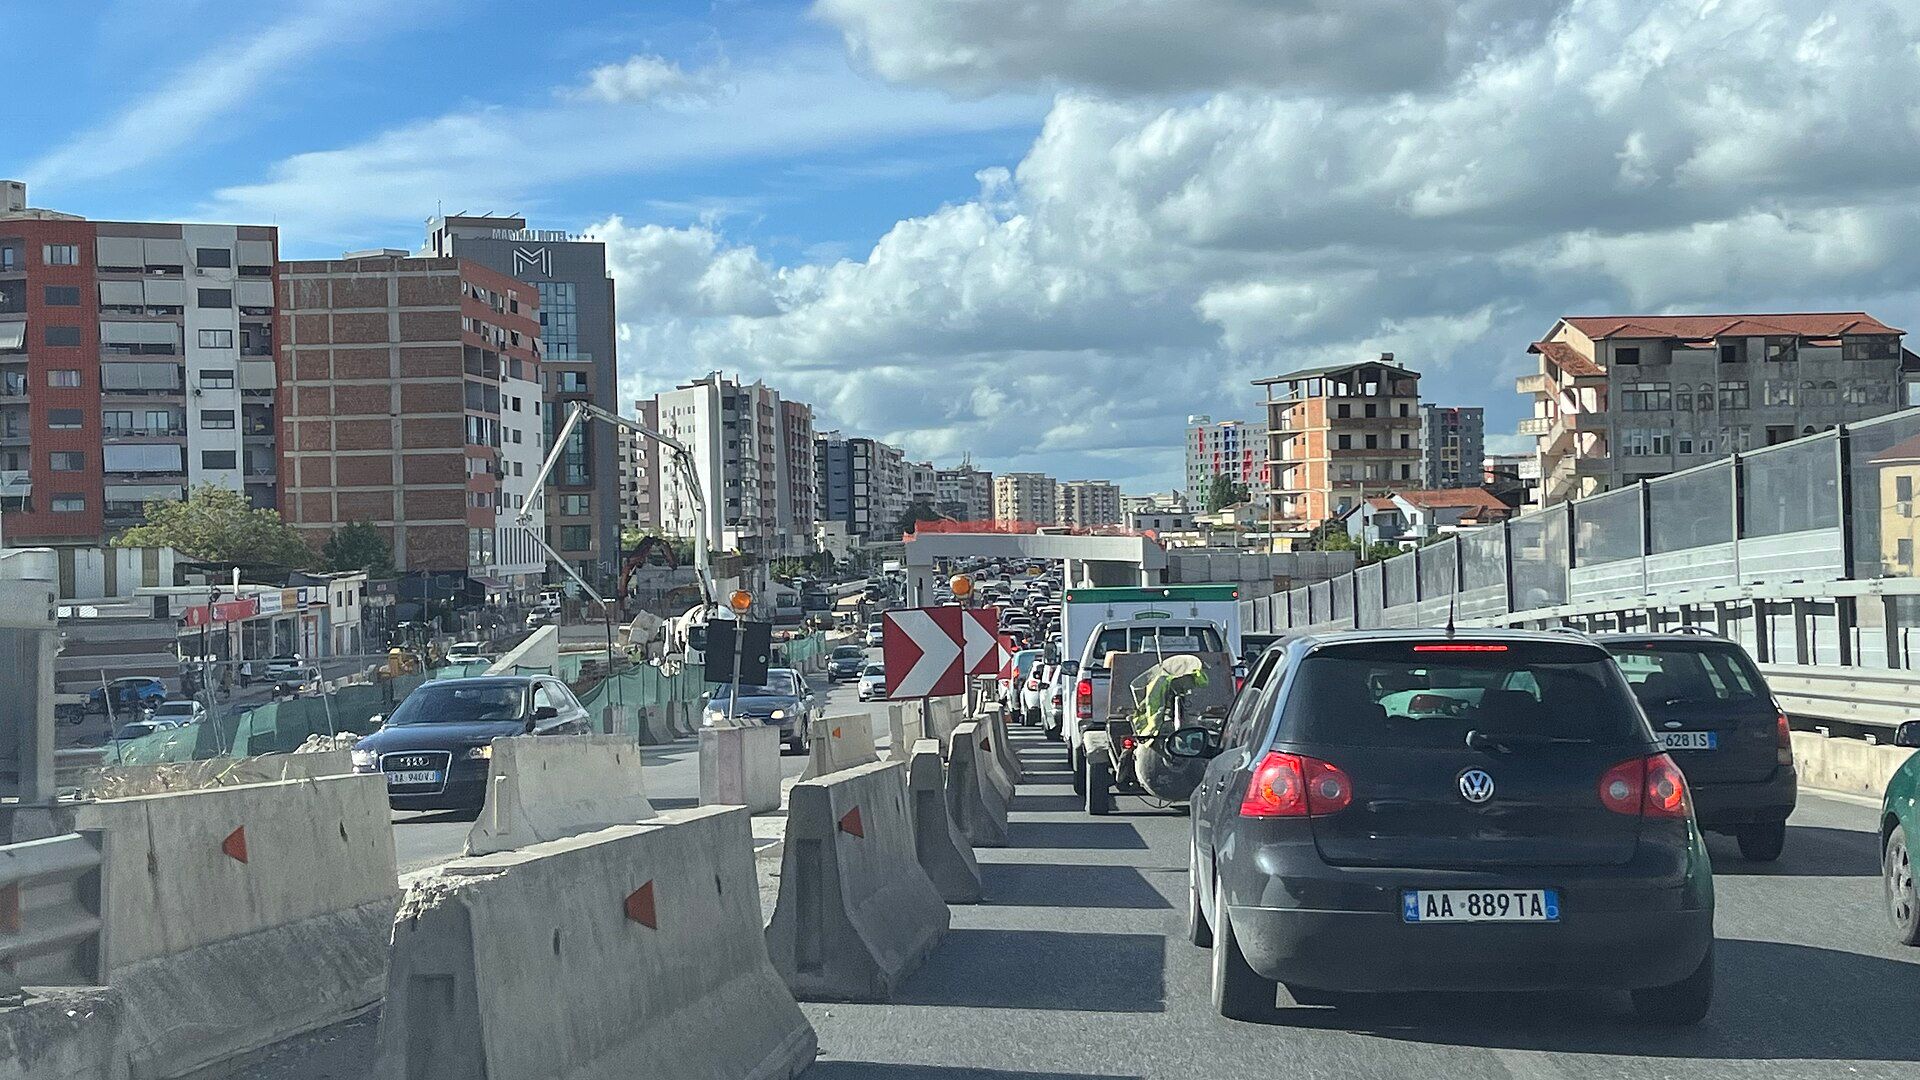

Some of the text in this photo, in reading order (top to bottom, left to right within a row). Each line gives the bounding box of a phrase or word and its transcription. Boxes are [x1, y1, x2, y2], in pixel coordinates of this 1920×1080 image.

[538, 230, 567, 241] HOTEL
[1666, 734, 1689, 746] 628
[1426, 893, 1544, 917] AA 889 TA
